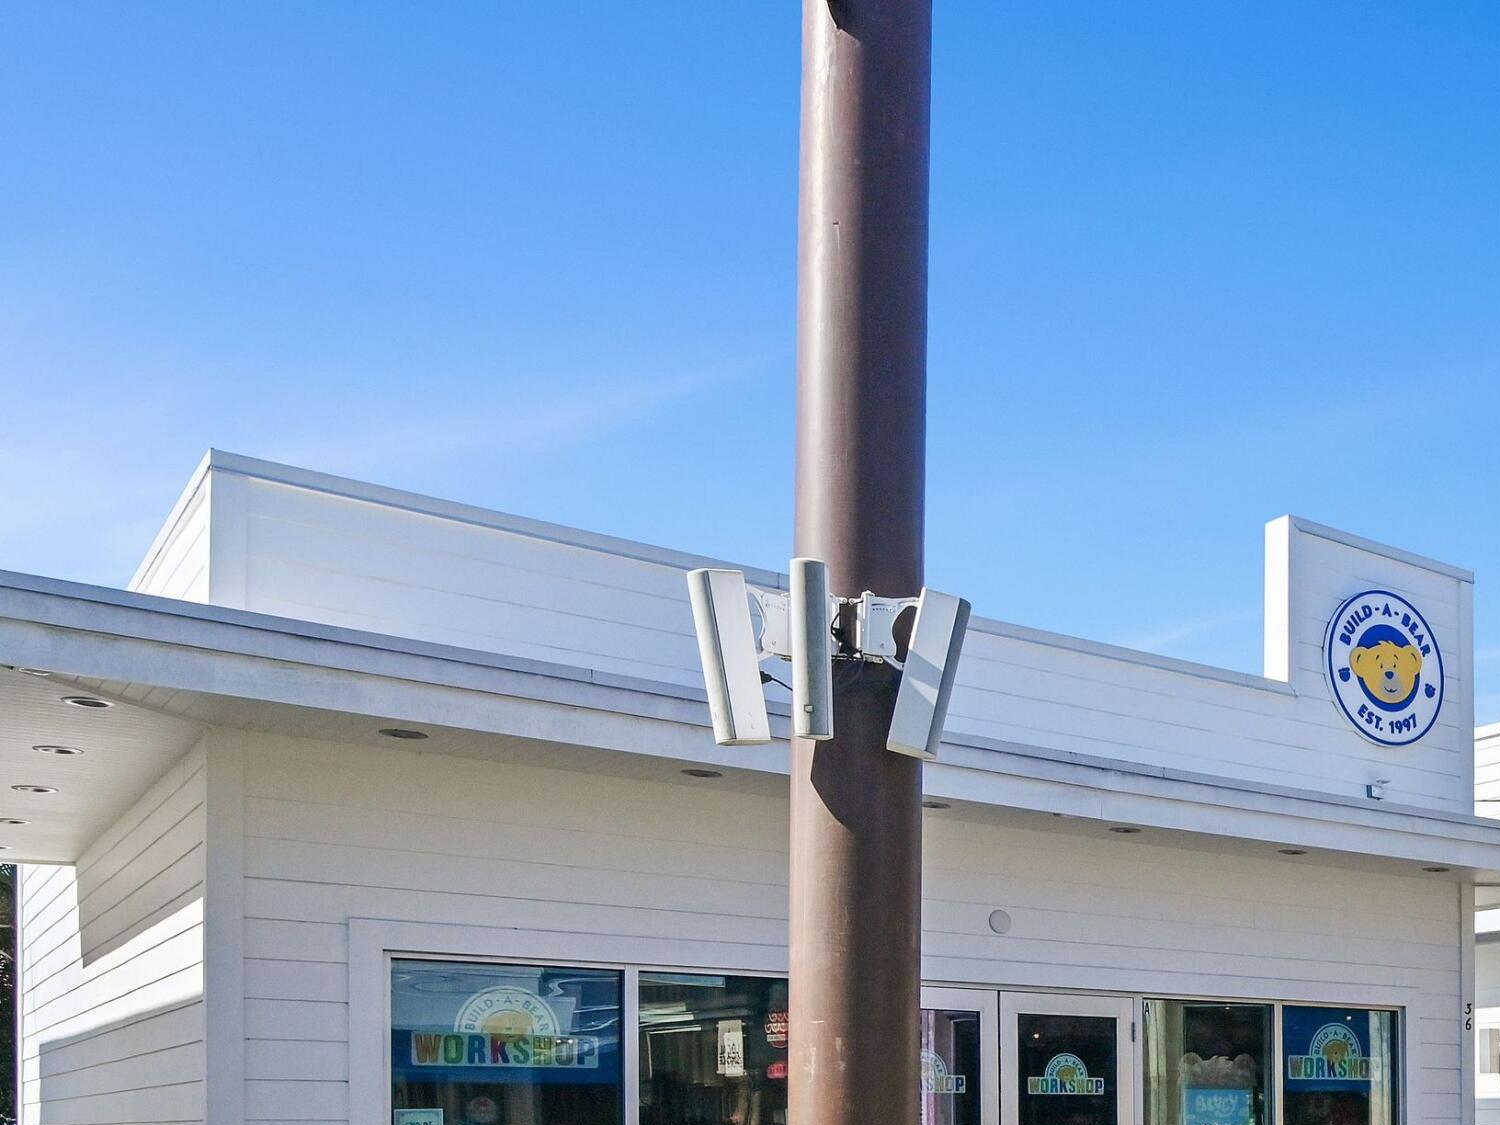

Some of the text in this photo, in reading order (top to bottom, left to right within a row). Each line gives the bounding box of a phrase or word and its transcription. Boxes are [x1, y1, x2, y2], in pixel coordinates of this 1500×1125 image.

[1339, 603, 1431, 657] BUILD-A-BEAR
[1357, 704, 1417, 734] EST. 1997
[465, 996, 550, 1031] BUILD-A-BEAR
[414, 1034, 596, 1066] WORKSHOP
[1289, 1056, 1381, 1079] WORKSHO
[1029, 1077, 1104, 1094] WORKSHOP
